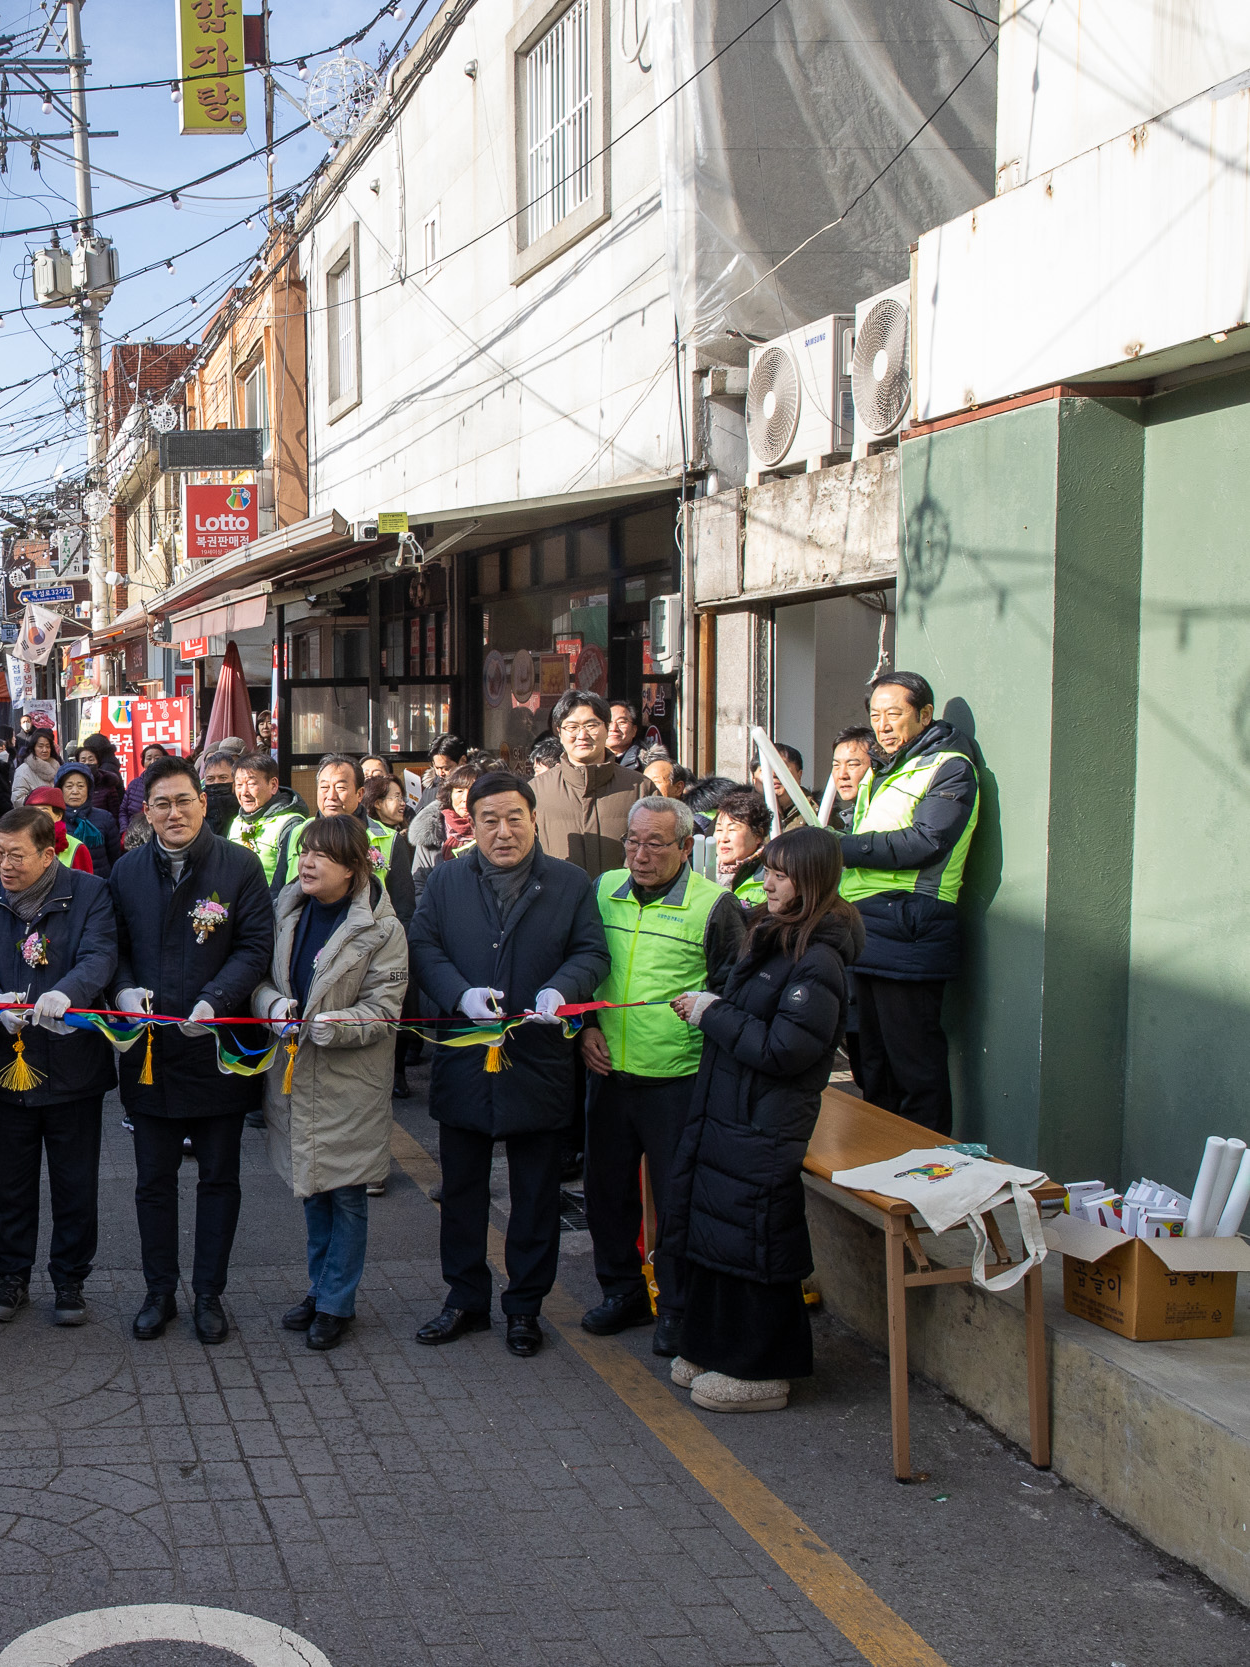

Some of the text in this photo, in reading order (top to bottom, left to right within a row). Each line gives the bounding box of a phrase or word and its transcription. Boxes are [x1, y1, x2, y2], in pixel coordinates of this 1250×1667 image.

[805, 332, 826, 347] SAMSUNG
[195, 514, 250, 531] Lotto
[196, 535, 250, 547] 복권판매점
